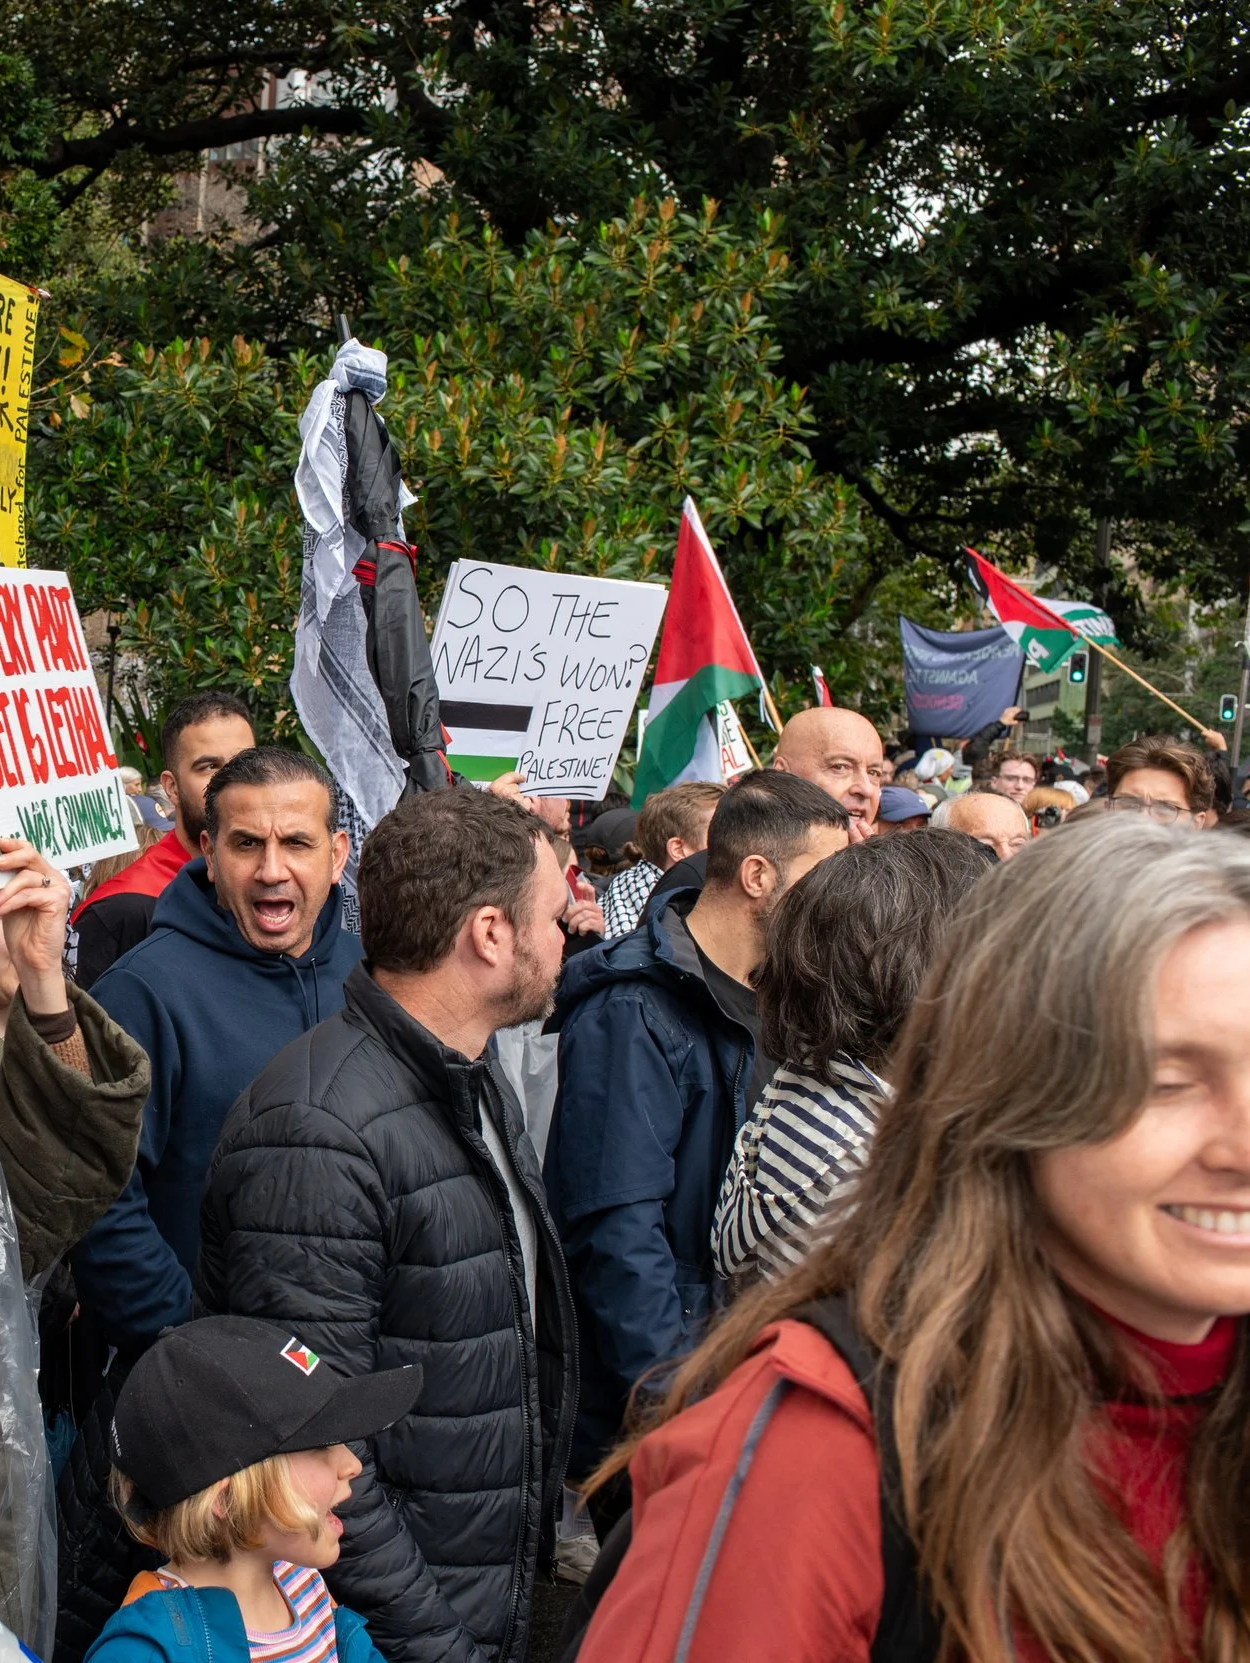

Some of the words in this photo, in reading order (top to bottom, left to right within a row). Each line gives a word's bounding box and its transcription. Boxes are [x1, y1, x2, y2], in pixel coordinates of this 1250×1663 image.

[15, 294, 38, 443] PALESTINE!
[15, 456, 25, 489] for
[23, 584, 88, 673] PART
[447, 567, 530, 633] SO
[549, 593, 620, 643] THE
[433, 634, 548, 685] NAZI'S
[560, 643, 648, 693] WON?
[11, 687, 50, 786] IS
[34, 684, 119, 780] LETHAL
[537, 699, 624, 748] FREE
[519, 750, 614, 784] PALESTINE!
[16, 798, 62, 858] WAR
[54, 776, 126, 852] CRIMINALS!
